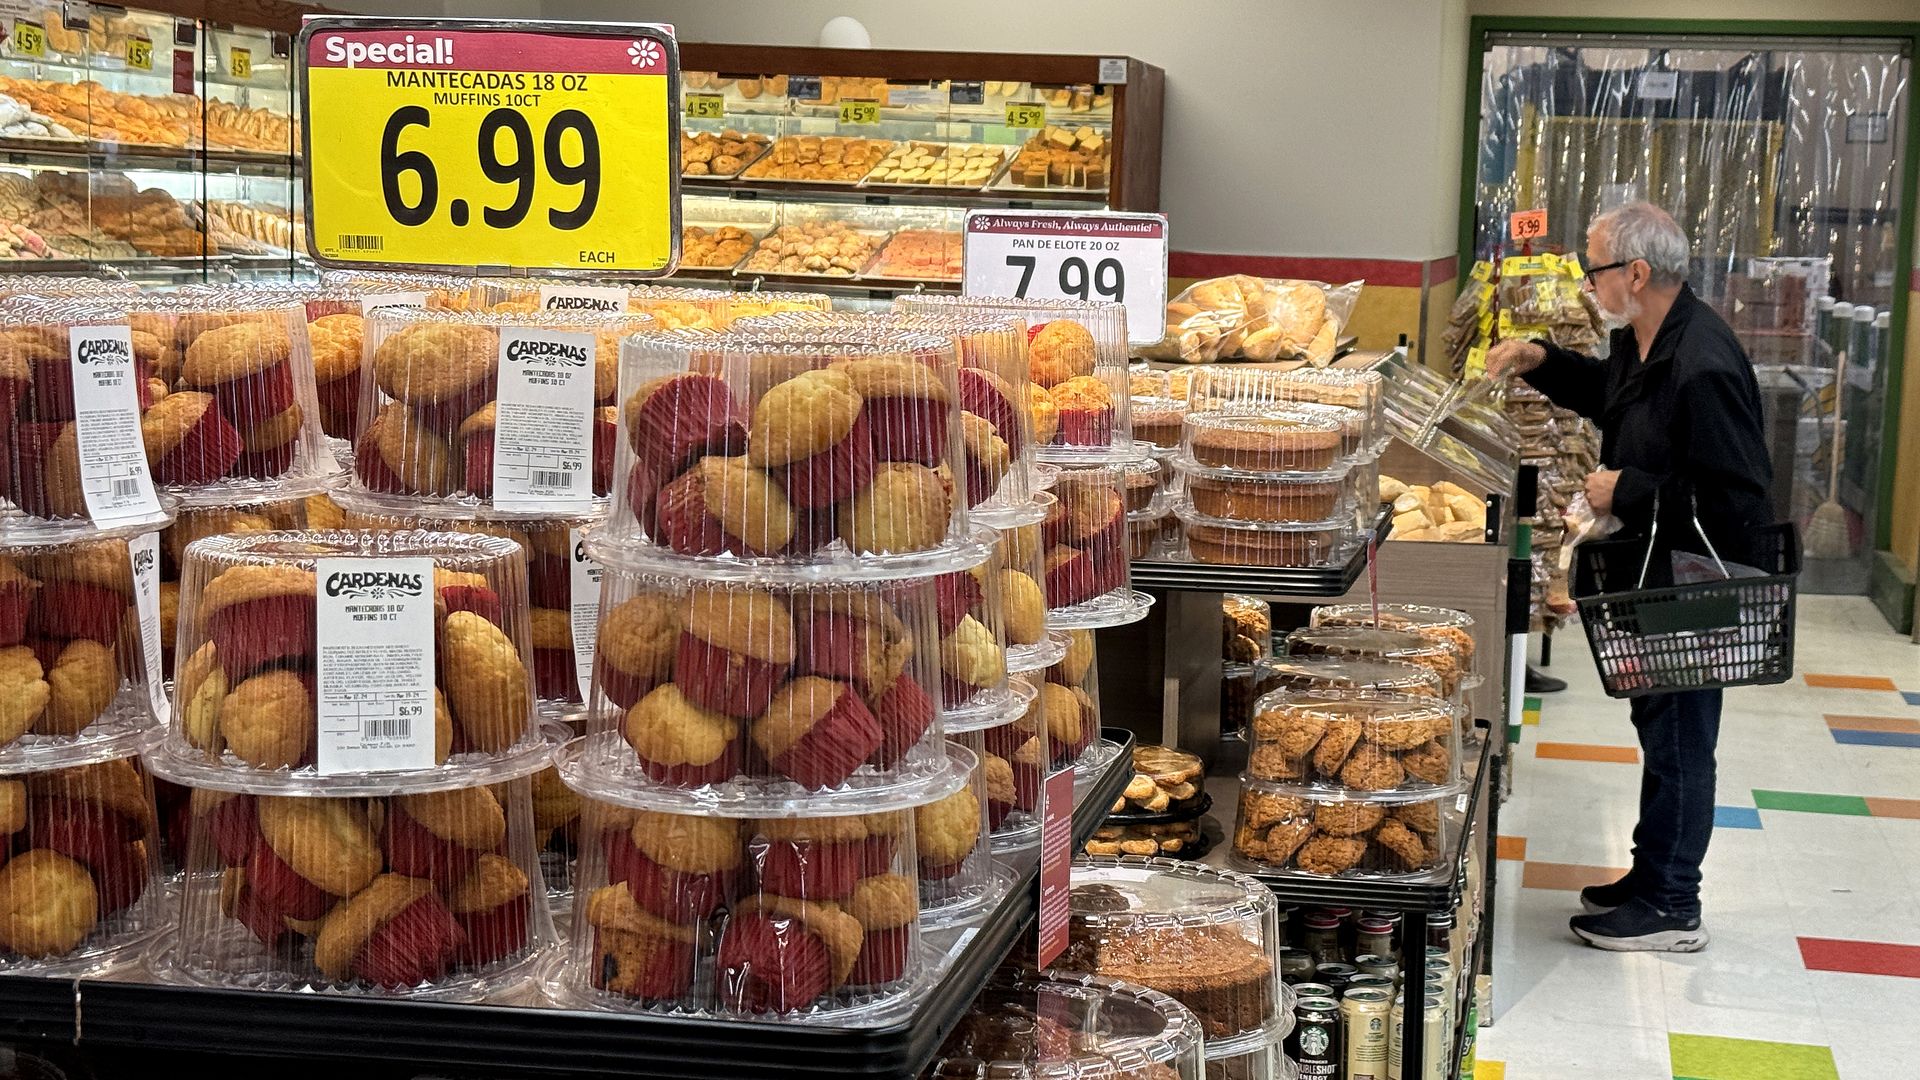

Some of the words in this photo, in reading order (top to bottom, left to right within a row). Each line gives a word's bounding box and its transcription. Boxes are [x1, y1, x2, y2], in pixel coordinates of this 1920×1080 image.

[326, 35, 454, 68] Special!
[387, 71, 526, 90] MANTECADAS
[533, 74, 554, 91] 18
[561, 75, 588, 91] OZ
[434, 92, 501, 106] MUFFINS
[506, 94, 541, 107] 10CT
[380, 105, 601, 230] 6.99
[992, 218, 1030, 230] Always
[1032, 220, 1061, 230] Fresh,
[1062, 221, 1100, 232] Always
[1013, 239, 1034, 248] PAN
[1038, 240, 1052, 249] DE
[1054, 240, 1086, 250] ELOTE
[1090, 242, 1102, 250] 20
[1105, 242, 1120, 251] OZ
[579, 251, 616, 264] EACH
[547, 296, 619, 312] CARDENAS
[78, 339, 129, 364] CARDENAS
[507, 340, 587, 362] CARDENAS
[562, 461, 582, 471] $6.99
[326, 572, 422, 597] CARDENAS
[399, 706, 422, 716] $6.99
